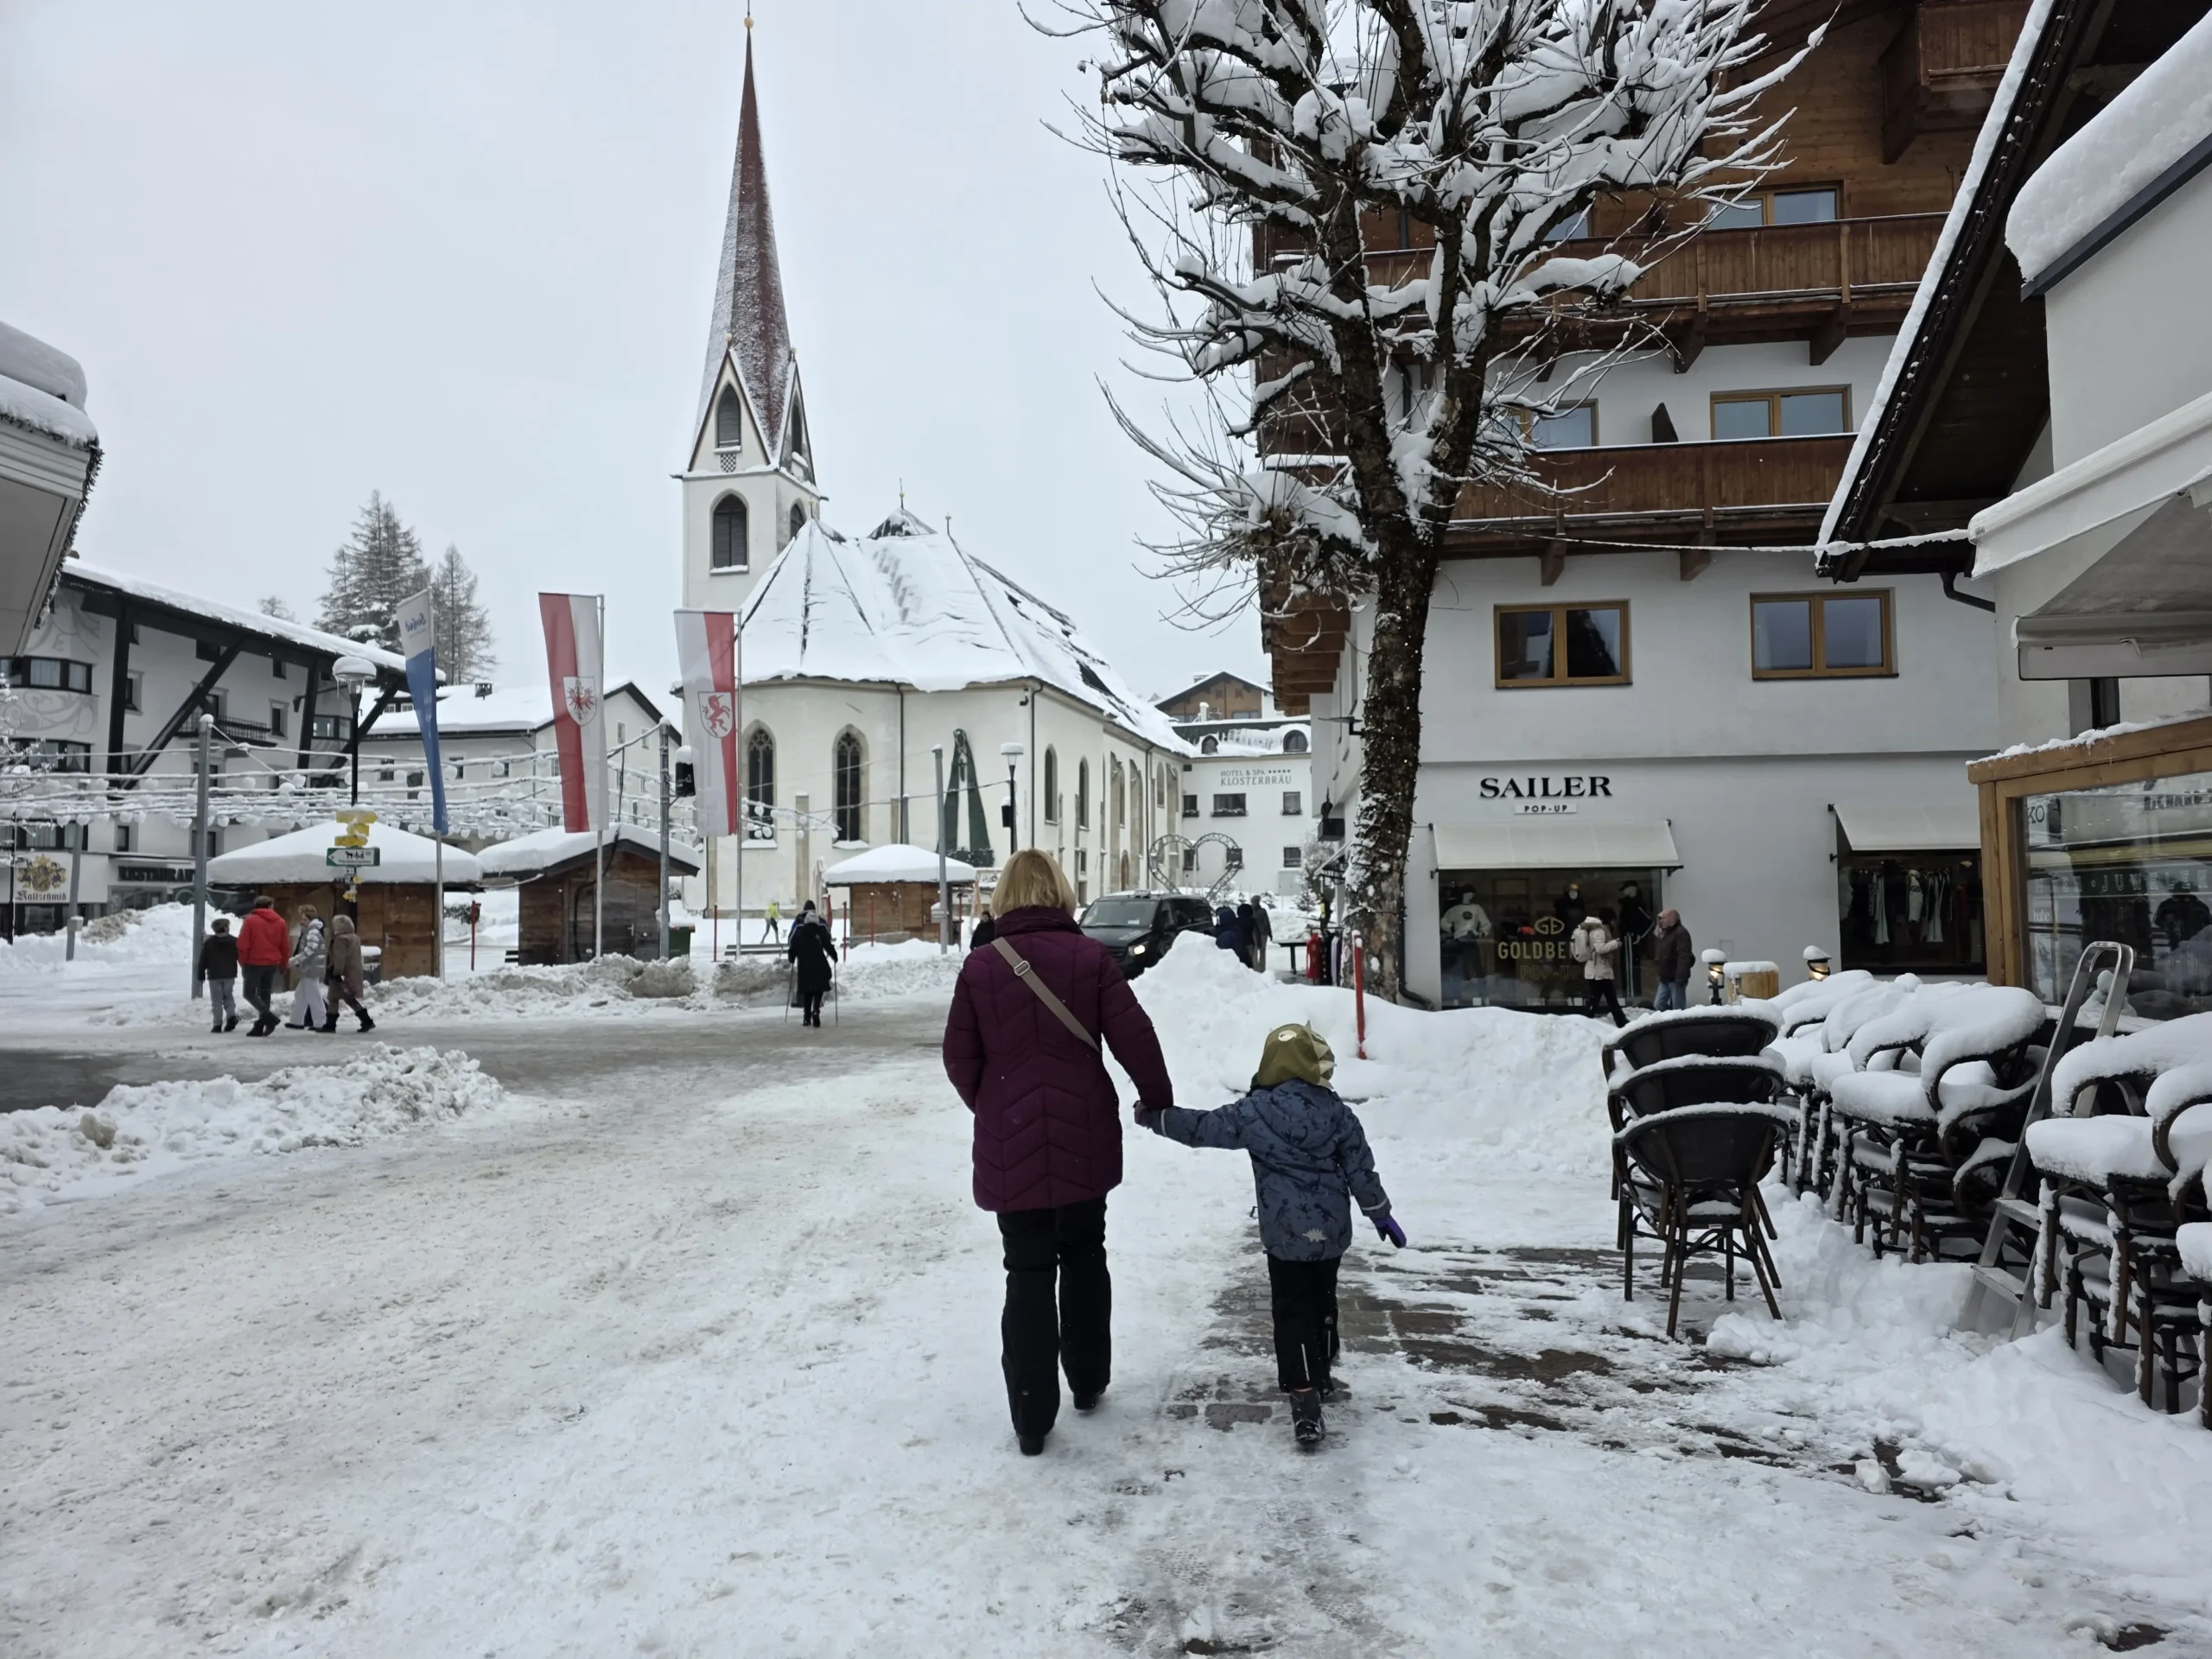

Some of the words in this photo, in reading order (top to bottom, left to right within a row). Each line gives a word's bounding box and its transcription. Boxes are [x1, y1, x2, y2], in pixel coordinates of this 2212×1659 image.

[1220, 775, 1292, 786] KLOSTERBRÄU
[1479, 776, 1613, 798] SAILER
[1524, 804, 1567, 813] POP-UP
[2101, 869, 2209, 893] JUWELEN
[1497, 942, 1573, 959] GOLDBE
